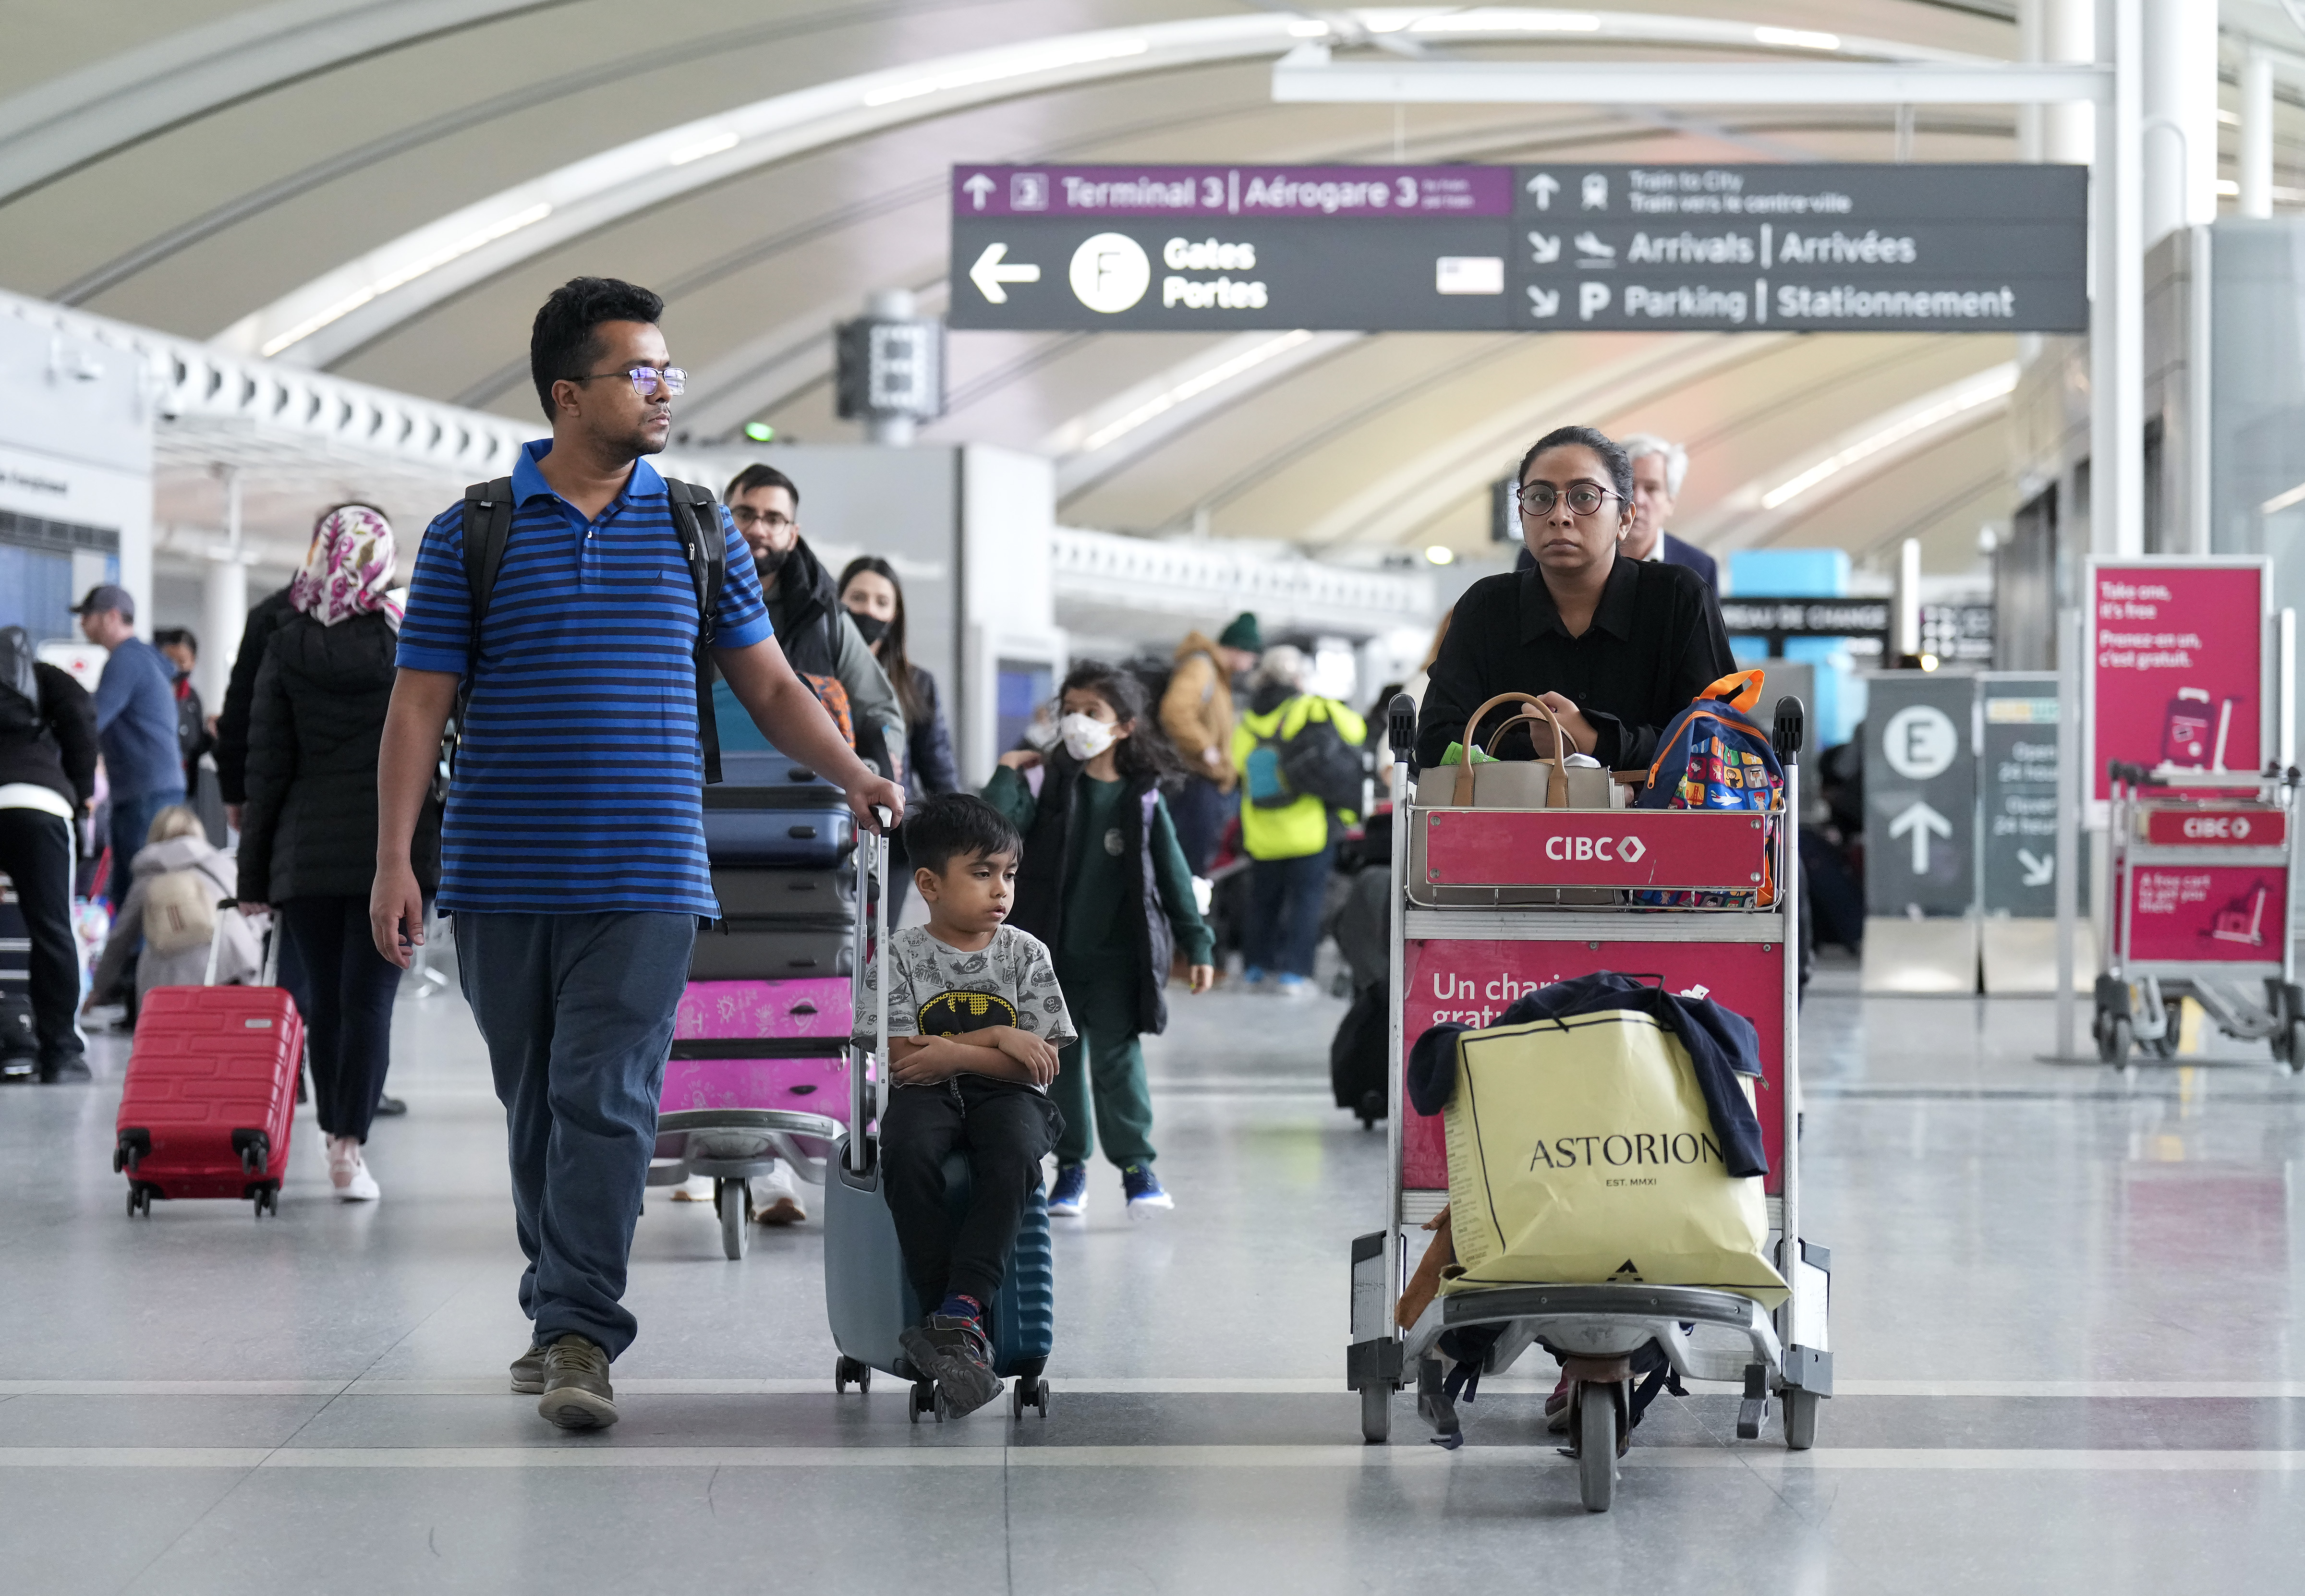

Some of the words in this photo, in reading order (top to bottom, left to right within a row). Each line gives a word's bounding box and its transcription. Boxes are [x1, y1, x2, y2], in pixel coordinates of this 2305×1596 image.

[1061, 176, 1196, 208] Terminal
[1201, 176, 1225, 208] 3
[1244, 174, 1391, 214] Aérogare
[1395, 176, 1418, 208] 3
[1627, 192, 1678, 214] Train
[1163, 237, 1257, 271] Gates
[1627, 231, 1756, 264] Arrivals
[1779, 230, 1917, 264] Arrivées
[1097, 251, 1122, 293] F
[1162, 276, 1269, 309] Portes
[1625, 285, 1748, 323] Parking
[1777, 285, 2015, 318] Stationnement
[2099, 581, 2136, 600] Take
[1905, 721, 1934, 763] E
[1545, 836, 1614, 861] CIBC
[1433, 973, 1475, 1000] Un
[1530, 1132, 1725, 1172] ASTORION
[1606, 1179, 1626, 1187] EST.
[1630, 1178, 1657, 1186] MMXI
